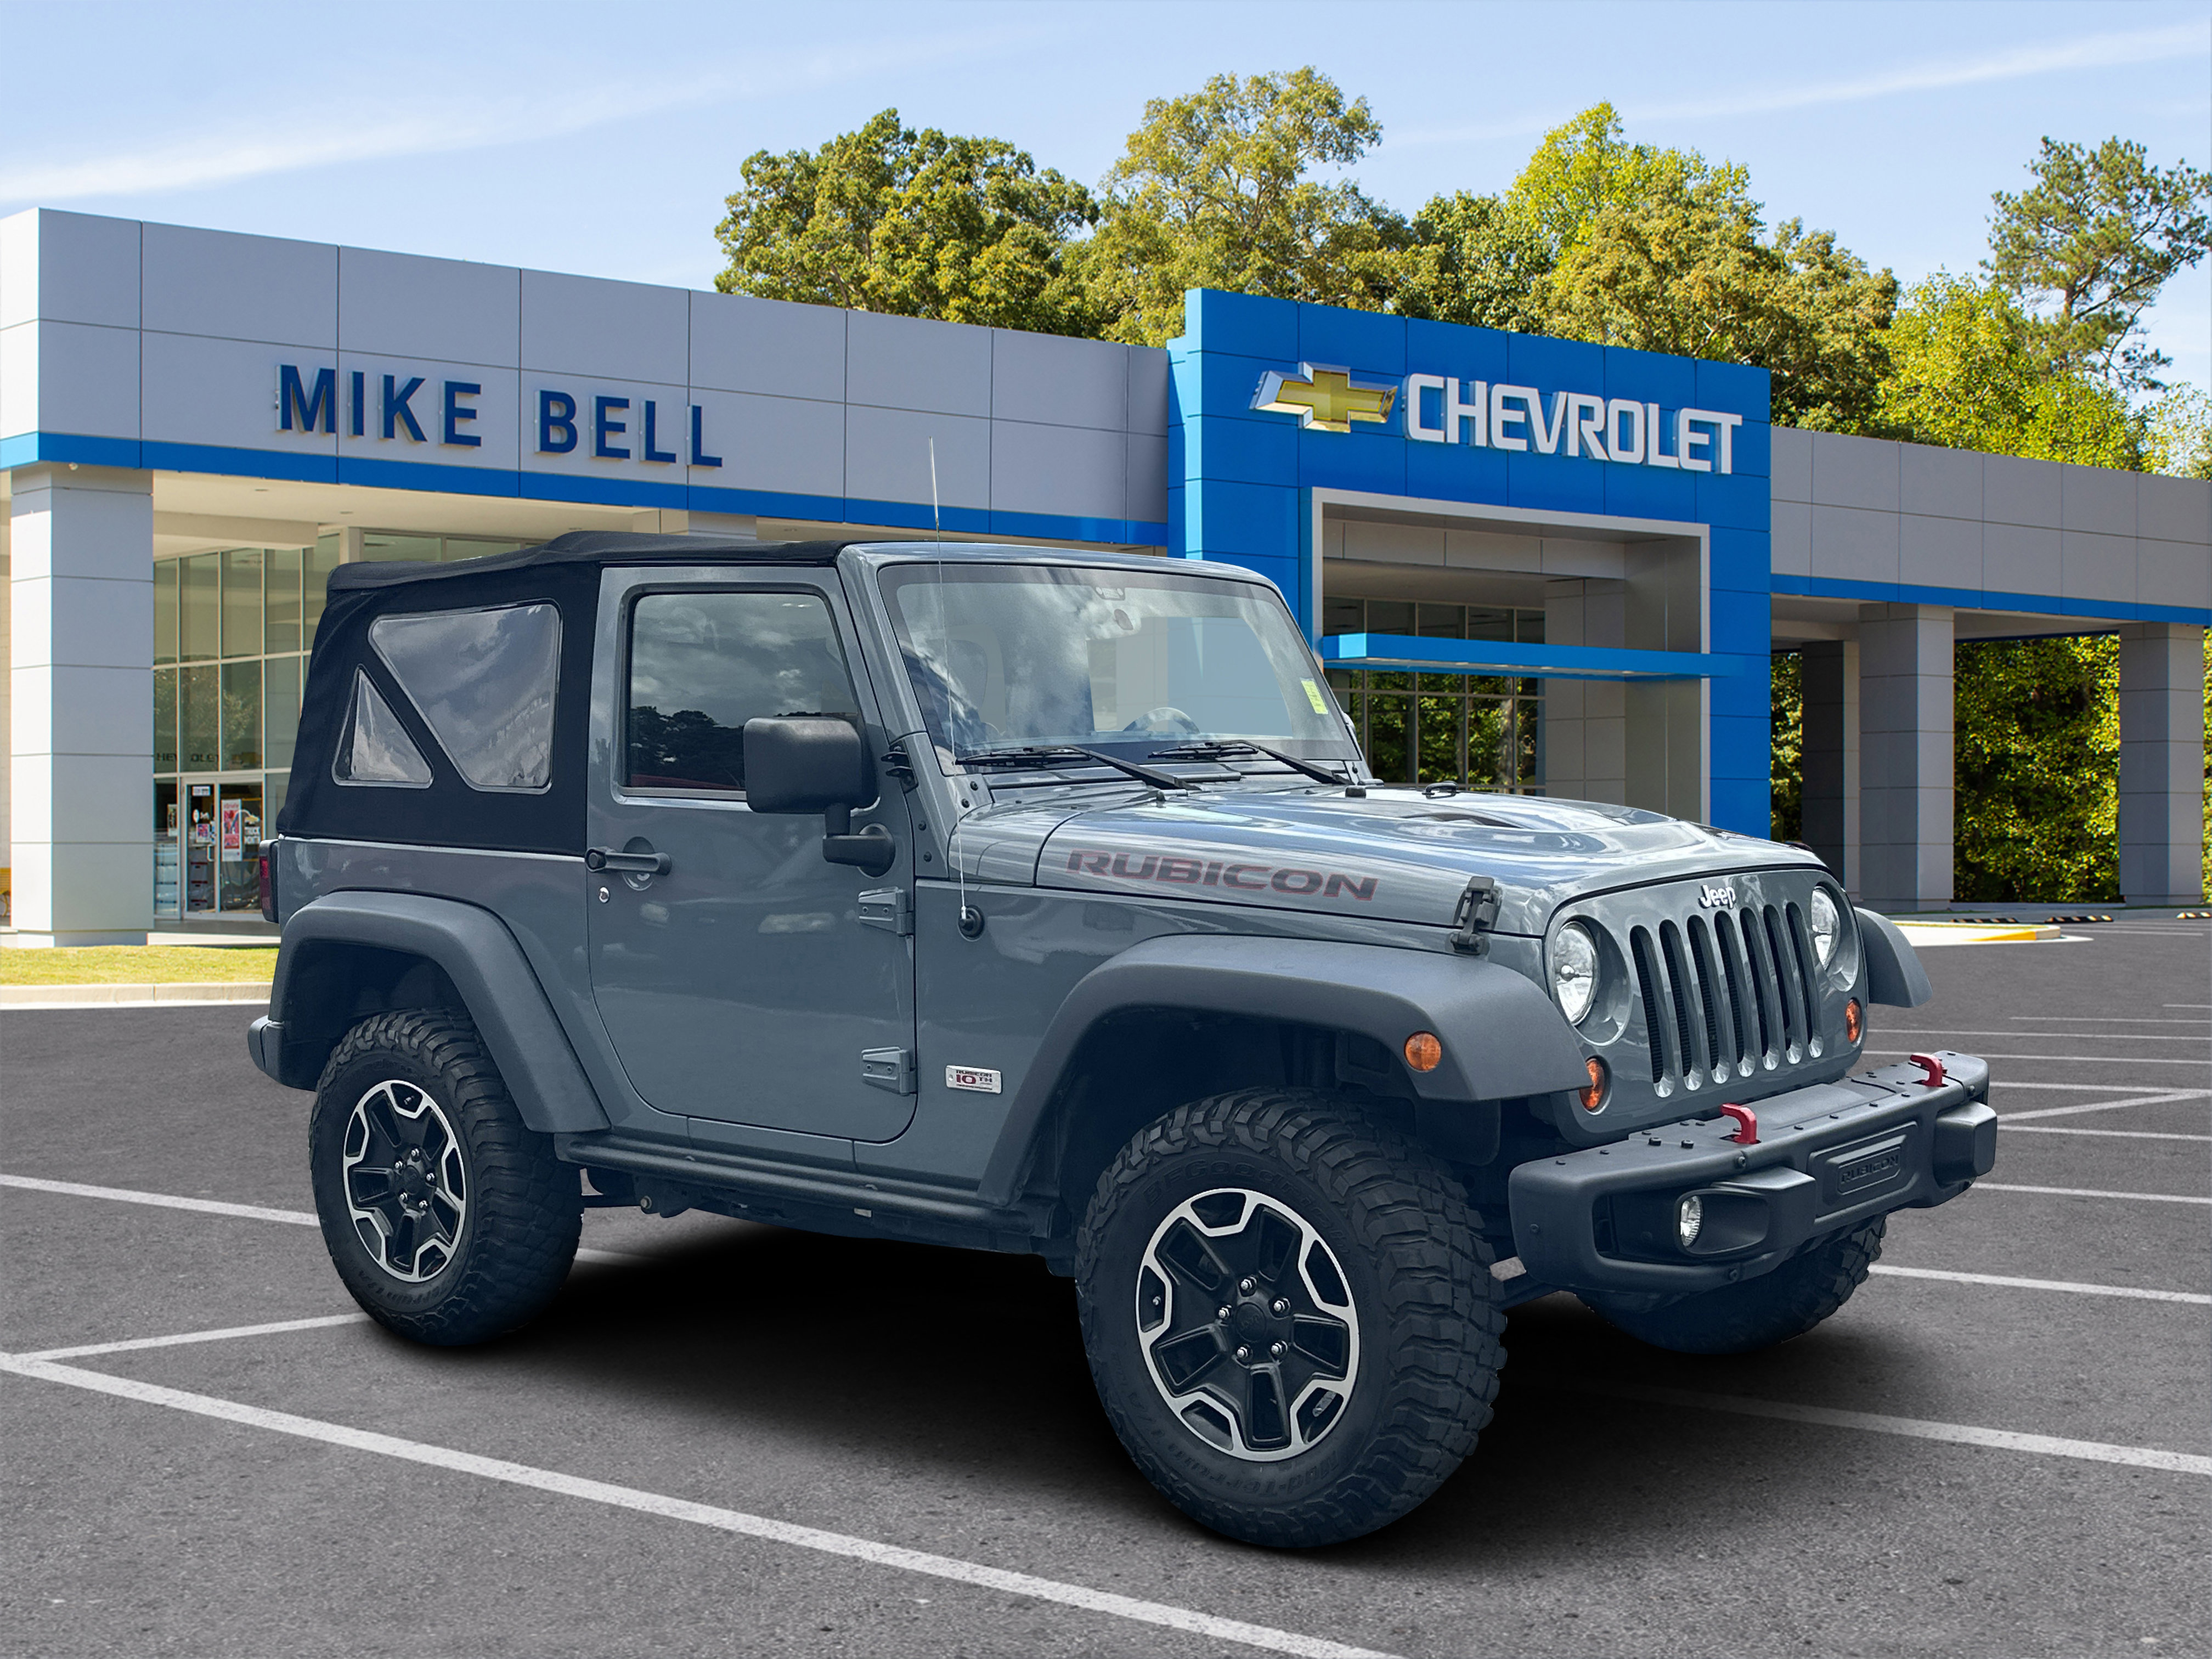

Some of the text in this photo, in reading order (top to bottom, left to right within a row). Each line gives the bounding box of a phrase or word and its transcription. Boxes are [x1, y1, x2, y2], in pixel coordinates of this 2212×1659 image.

[276, 364, 723, 467] MIKE BELL
[1402, 373, 1743, 475] CHEVROLET
[1066, 849, 1379, 901] RUBICON
[1699, 884, 1736, 909] Jeep
[1841, 1155, 1899, 1184] RUBICON
